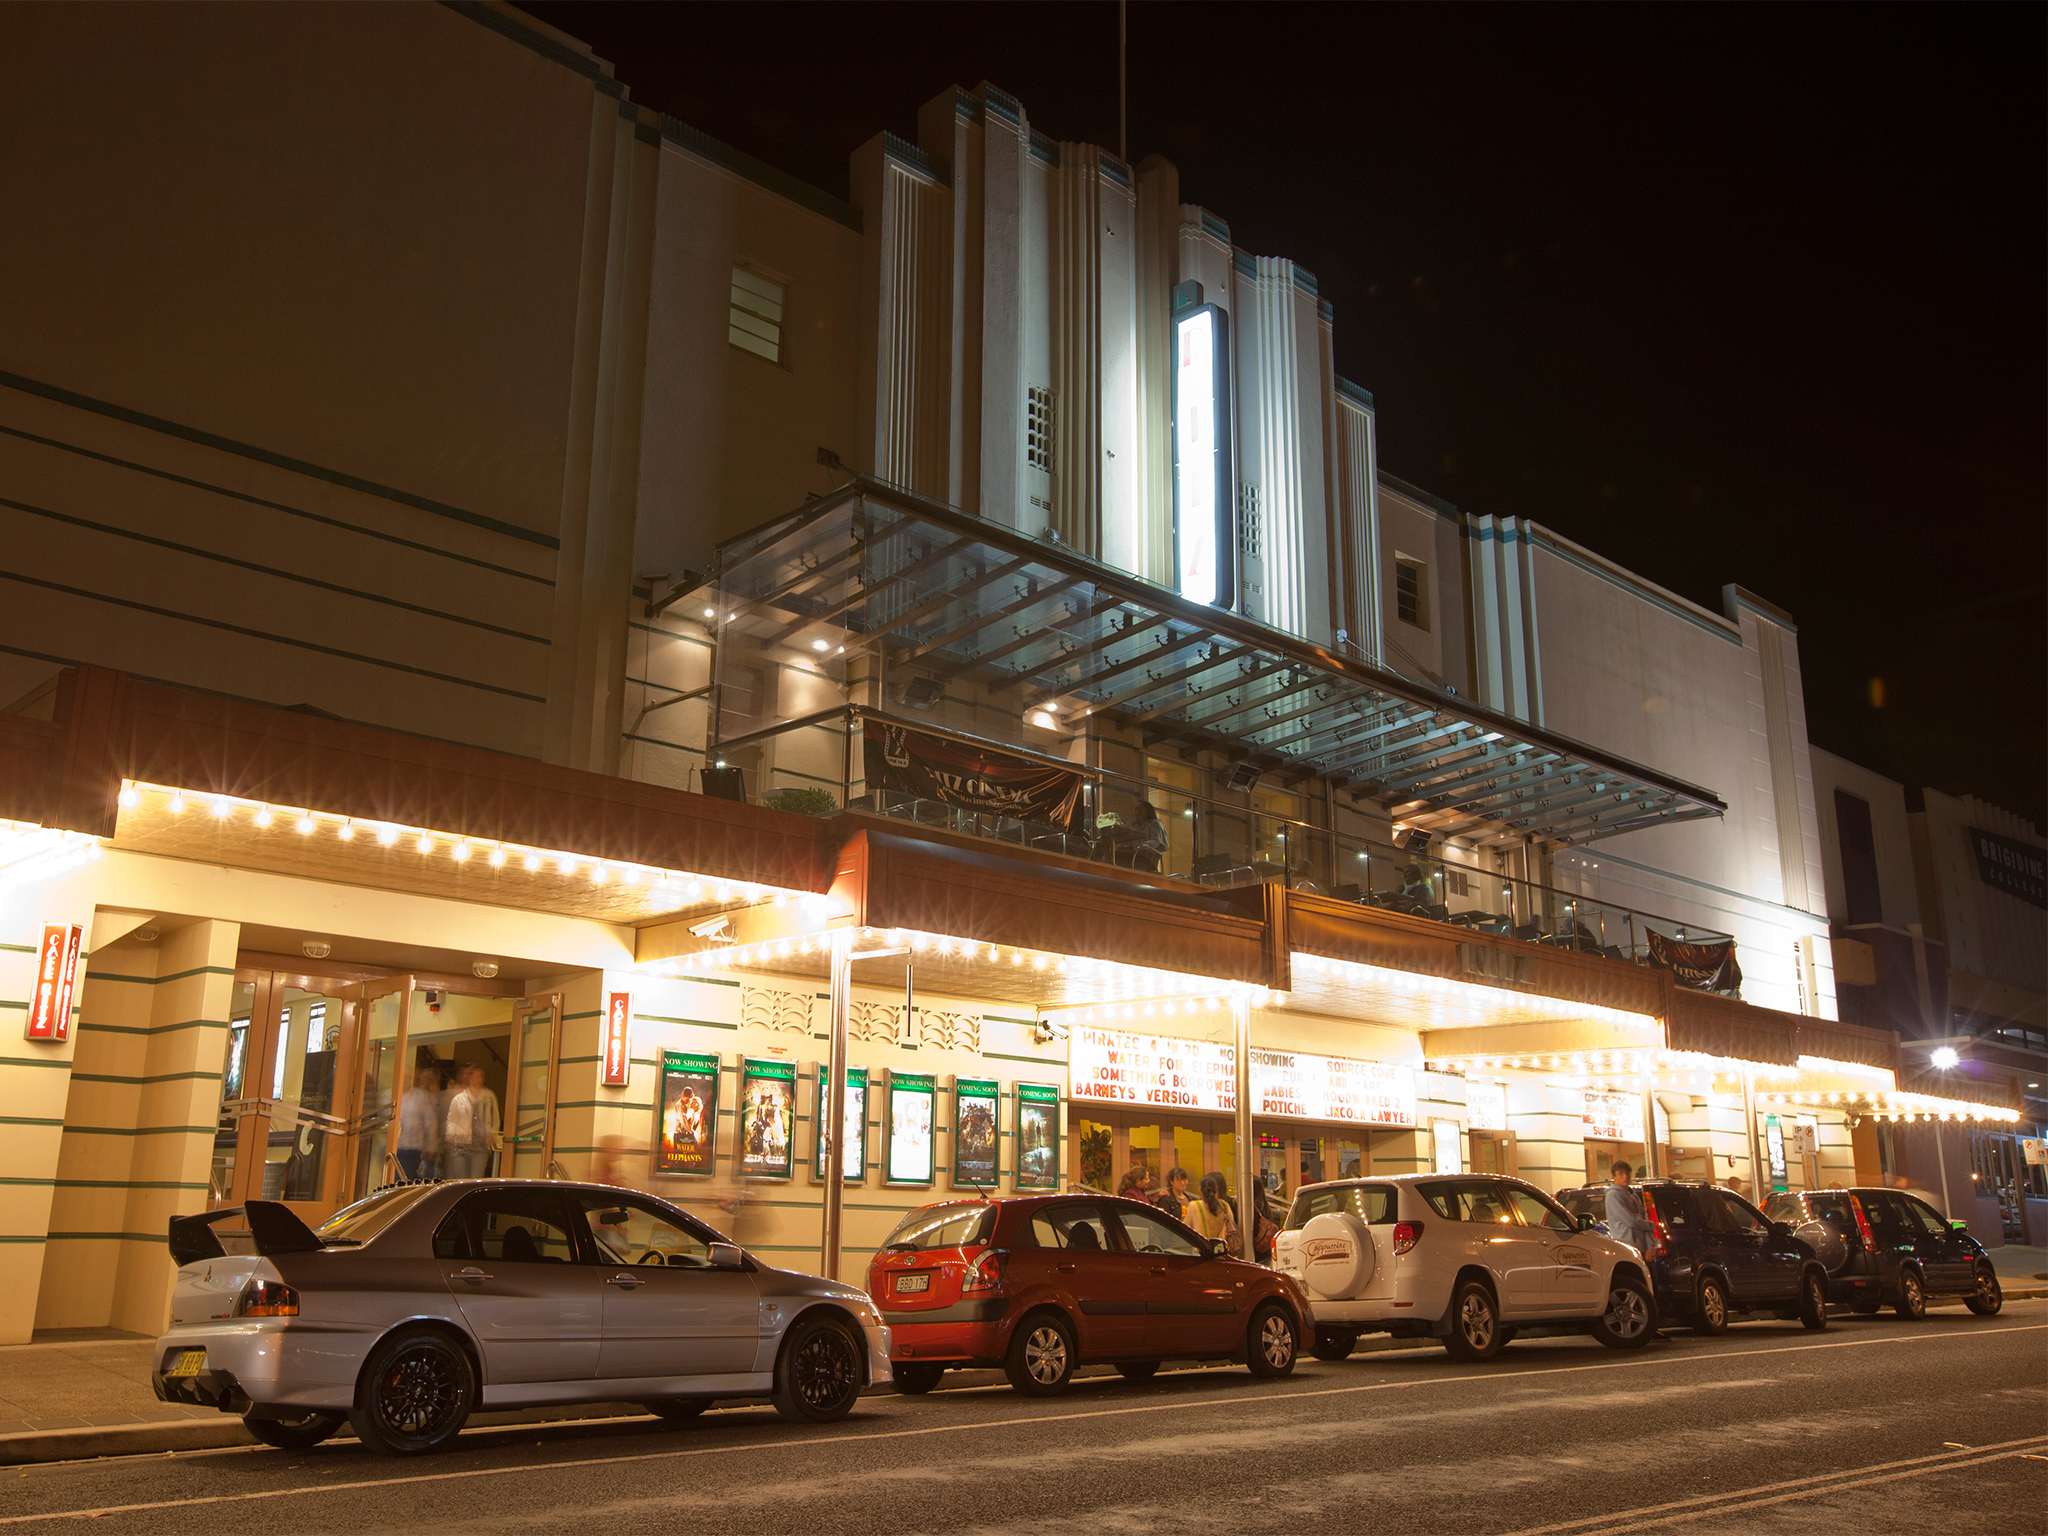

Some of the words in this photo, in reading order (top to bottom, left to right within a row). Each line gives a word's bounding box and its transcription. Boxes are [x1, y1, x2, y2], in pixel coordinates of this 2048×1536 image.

[1980, 837, 2045, 881] BRIGIDINE
[1990, 867, 2043, 899] COLLEGE
[44, 934, 60, 980] CAFE
[613, 999, 625, 1037] CAFE
[1083, 1031, 1140, 1050] PIRATES
[664, 1058, 682, 1066] NOW
[682, 1059, 718, 1070] SHOWING
[1107, 1050, 1150, 1068] WATER
[1159, 1057, 1182, 1071] FOR
[1219, 1048, 1235, 1061] NO
[1249, 1051, 1295, 1068] SHOWING
[745, 1065, 761, 1073] NOW
[763, 1066, 795, 1077] SHOWING
[1092, 1066, 1166, 1087] SOMETHING
[1192, 1060, 1258, 1079] ELEPHAS
[1326, 1060, 1366, 1076] SOURCE
[1371, 1066, 1397, 1079] CODE
[891, 1078, 905, 1086] NOW
[906, 1080, 935, 1088] SHOWING
[957, 1084, 981, 1092] COMING
[982, 1085, 998, 1093] SOON
[1328, 1075, 1347, 1089] AND
[1019, 1089, 1041, 1097] COMING
[1042, 1091, 1057, 1099] SOON
[1075, 1082, 1136, 1100] BARNEYS
[1146, 1088, 1199, 1105] VERSION
[1263, 1085, 1302, 1099] BABIES
[1584, 1093, 1609, 1104] COMNG
[1217, 1095, 1236, 1109] THO
[1262, 1098, 1308, 1115] POTICHE
[1466, 1094, 1498, 1106] OUCHERS
[1324, 1105, 1366, 1121] LINCOLN
[1371, 1109, 1413, 1124] LAWYER
[1592, 1126, 1618, 1137] SUPER
[1794, 1126, 1802, 1134] 1P
[677, 1143, 695, 1152] WATER
[667, 1153, 702, 1161] ELEPHANTS
